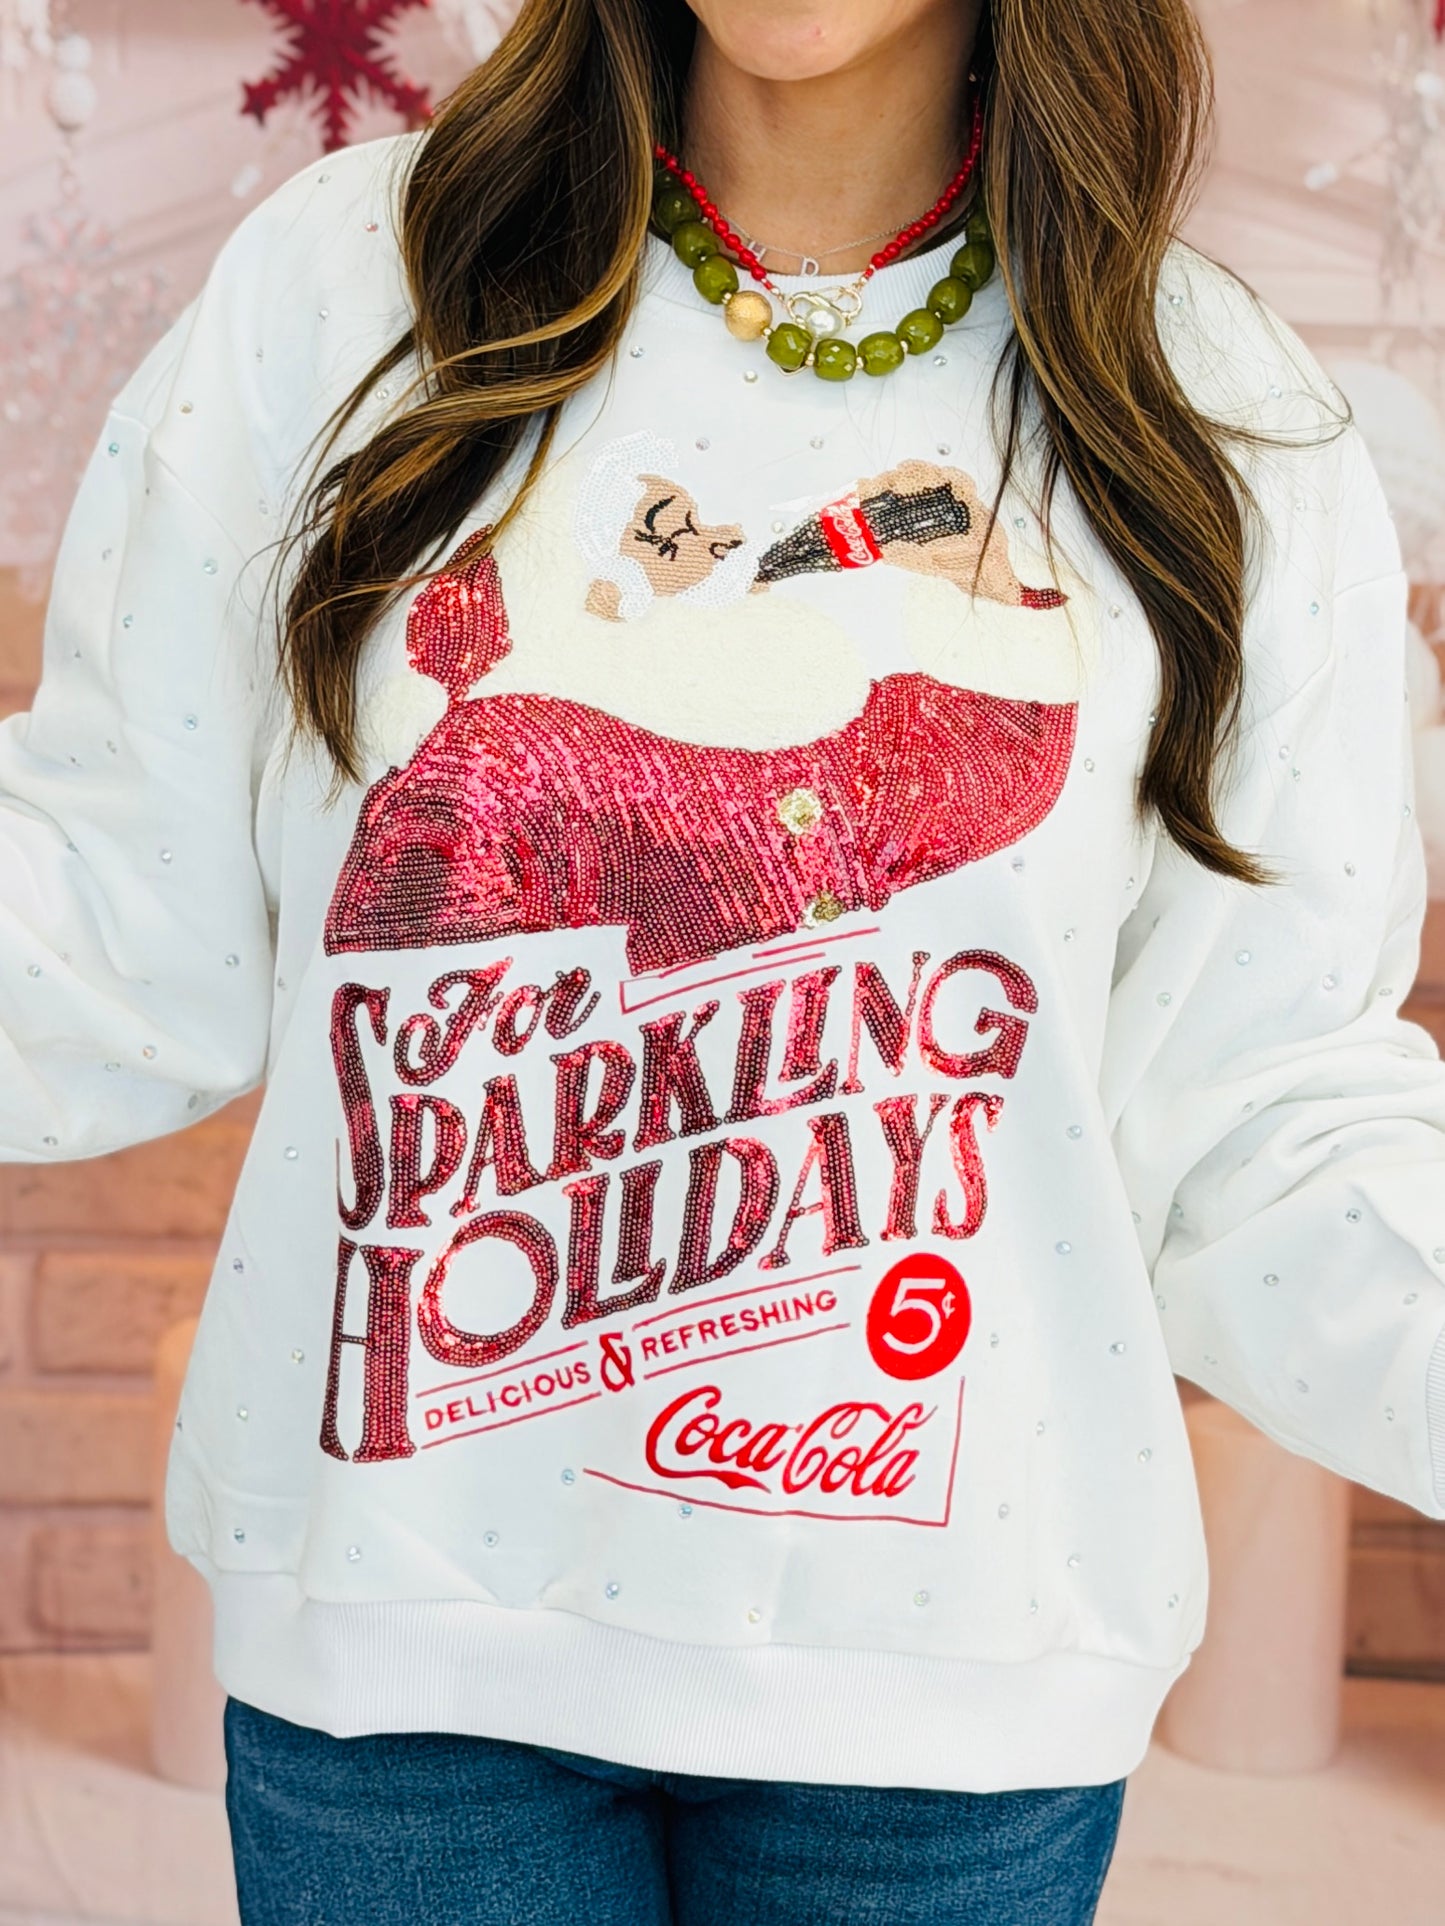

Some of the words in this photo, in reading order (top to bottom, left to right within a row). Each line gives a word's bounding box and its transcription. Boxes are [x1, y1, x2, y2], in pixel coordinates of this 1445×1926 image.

[329, 950, 1039, 1231] SPARKLING
[396, 956, 602, 1086] For
[319, 1092, 1005, 1463] HOLIDAYS
[424, 1361, 592, 1431] DELICIOUS
[599, 1331, 635, 1393] &
[643, 1289, 838, 1361] REFRESHING
[645, 1385, 939, 1497] Coca-Cola
